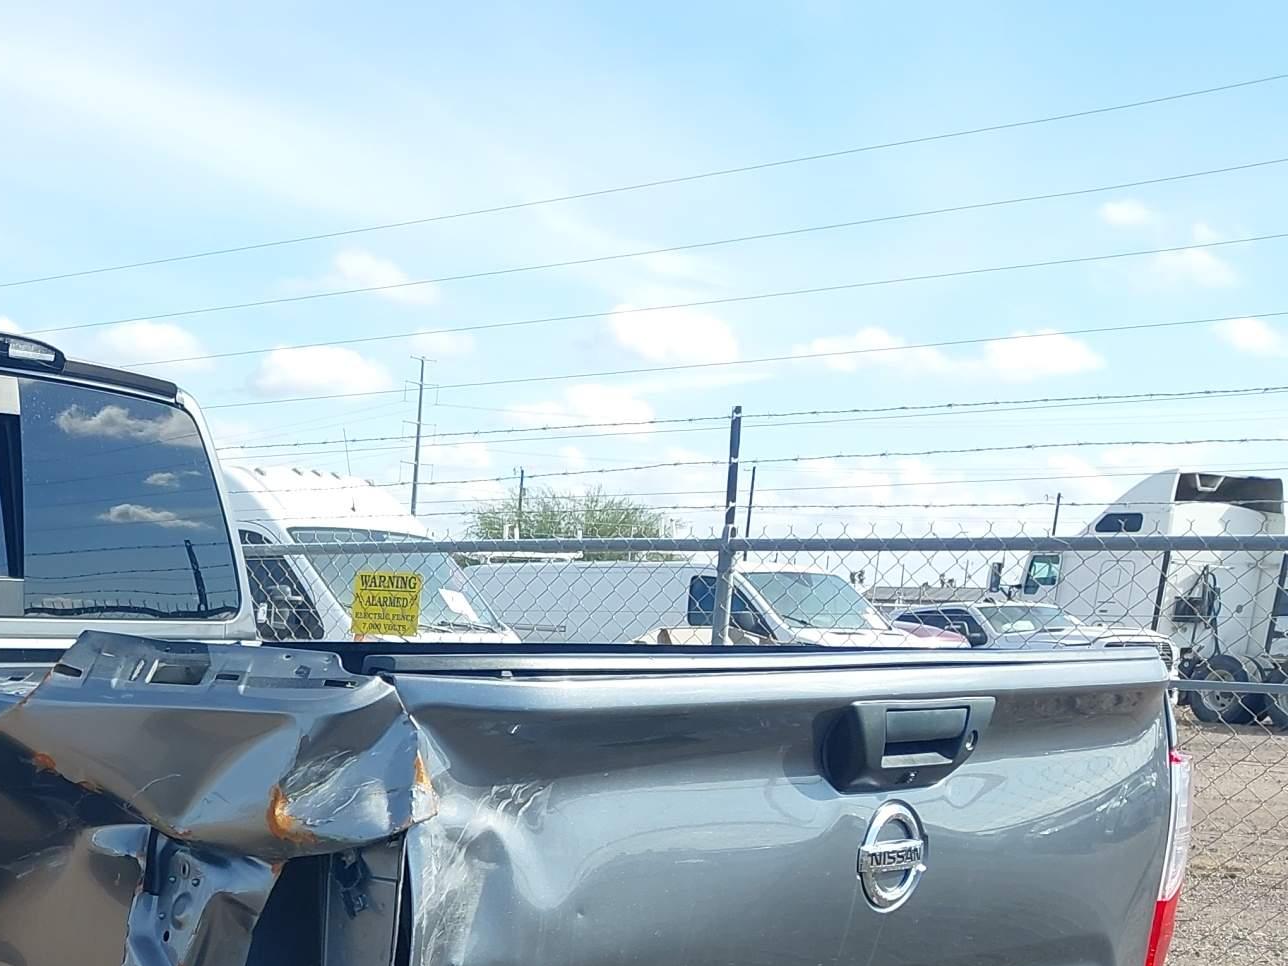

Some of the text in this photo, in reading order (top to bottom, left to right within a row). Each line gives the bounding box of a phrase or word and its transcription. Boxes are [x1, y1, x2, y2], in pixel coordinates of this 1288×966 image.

[360, 574, 417, 589] WARNING
[365, 595, 409, 608] ALARMED
[355, 611, 416, 622] ELECTRIC FENCE
[383, 623, 407, 631] VOLTS
[868, 846, 921, 866] NISSAN
